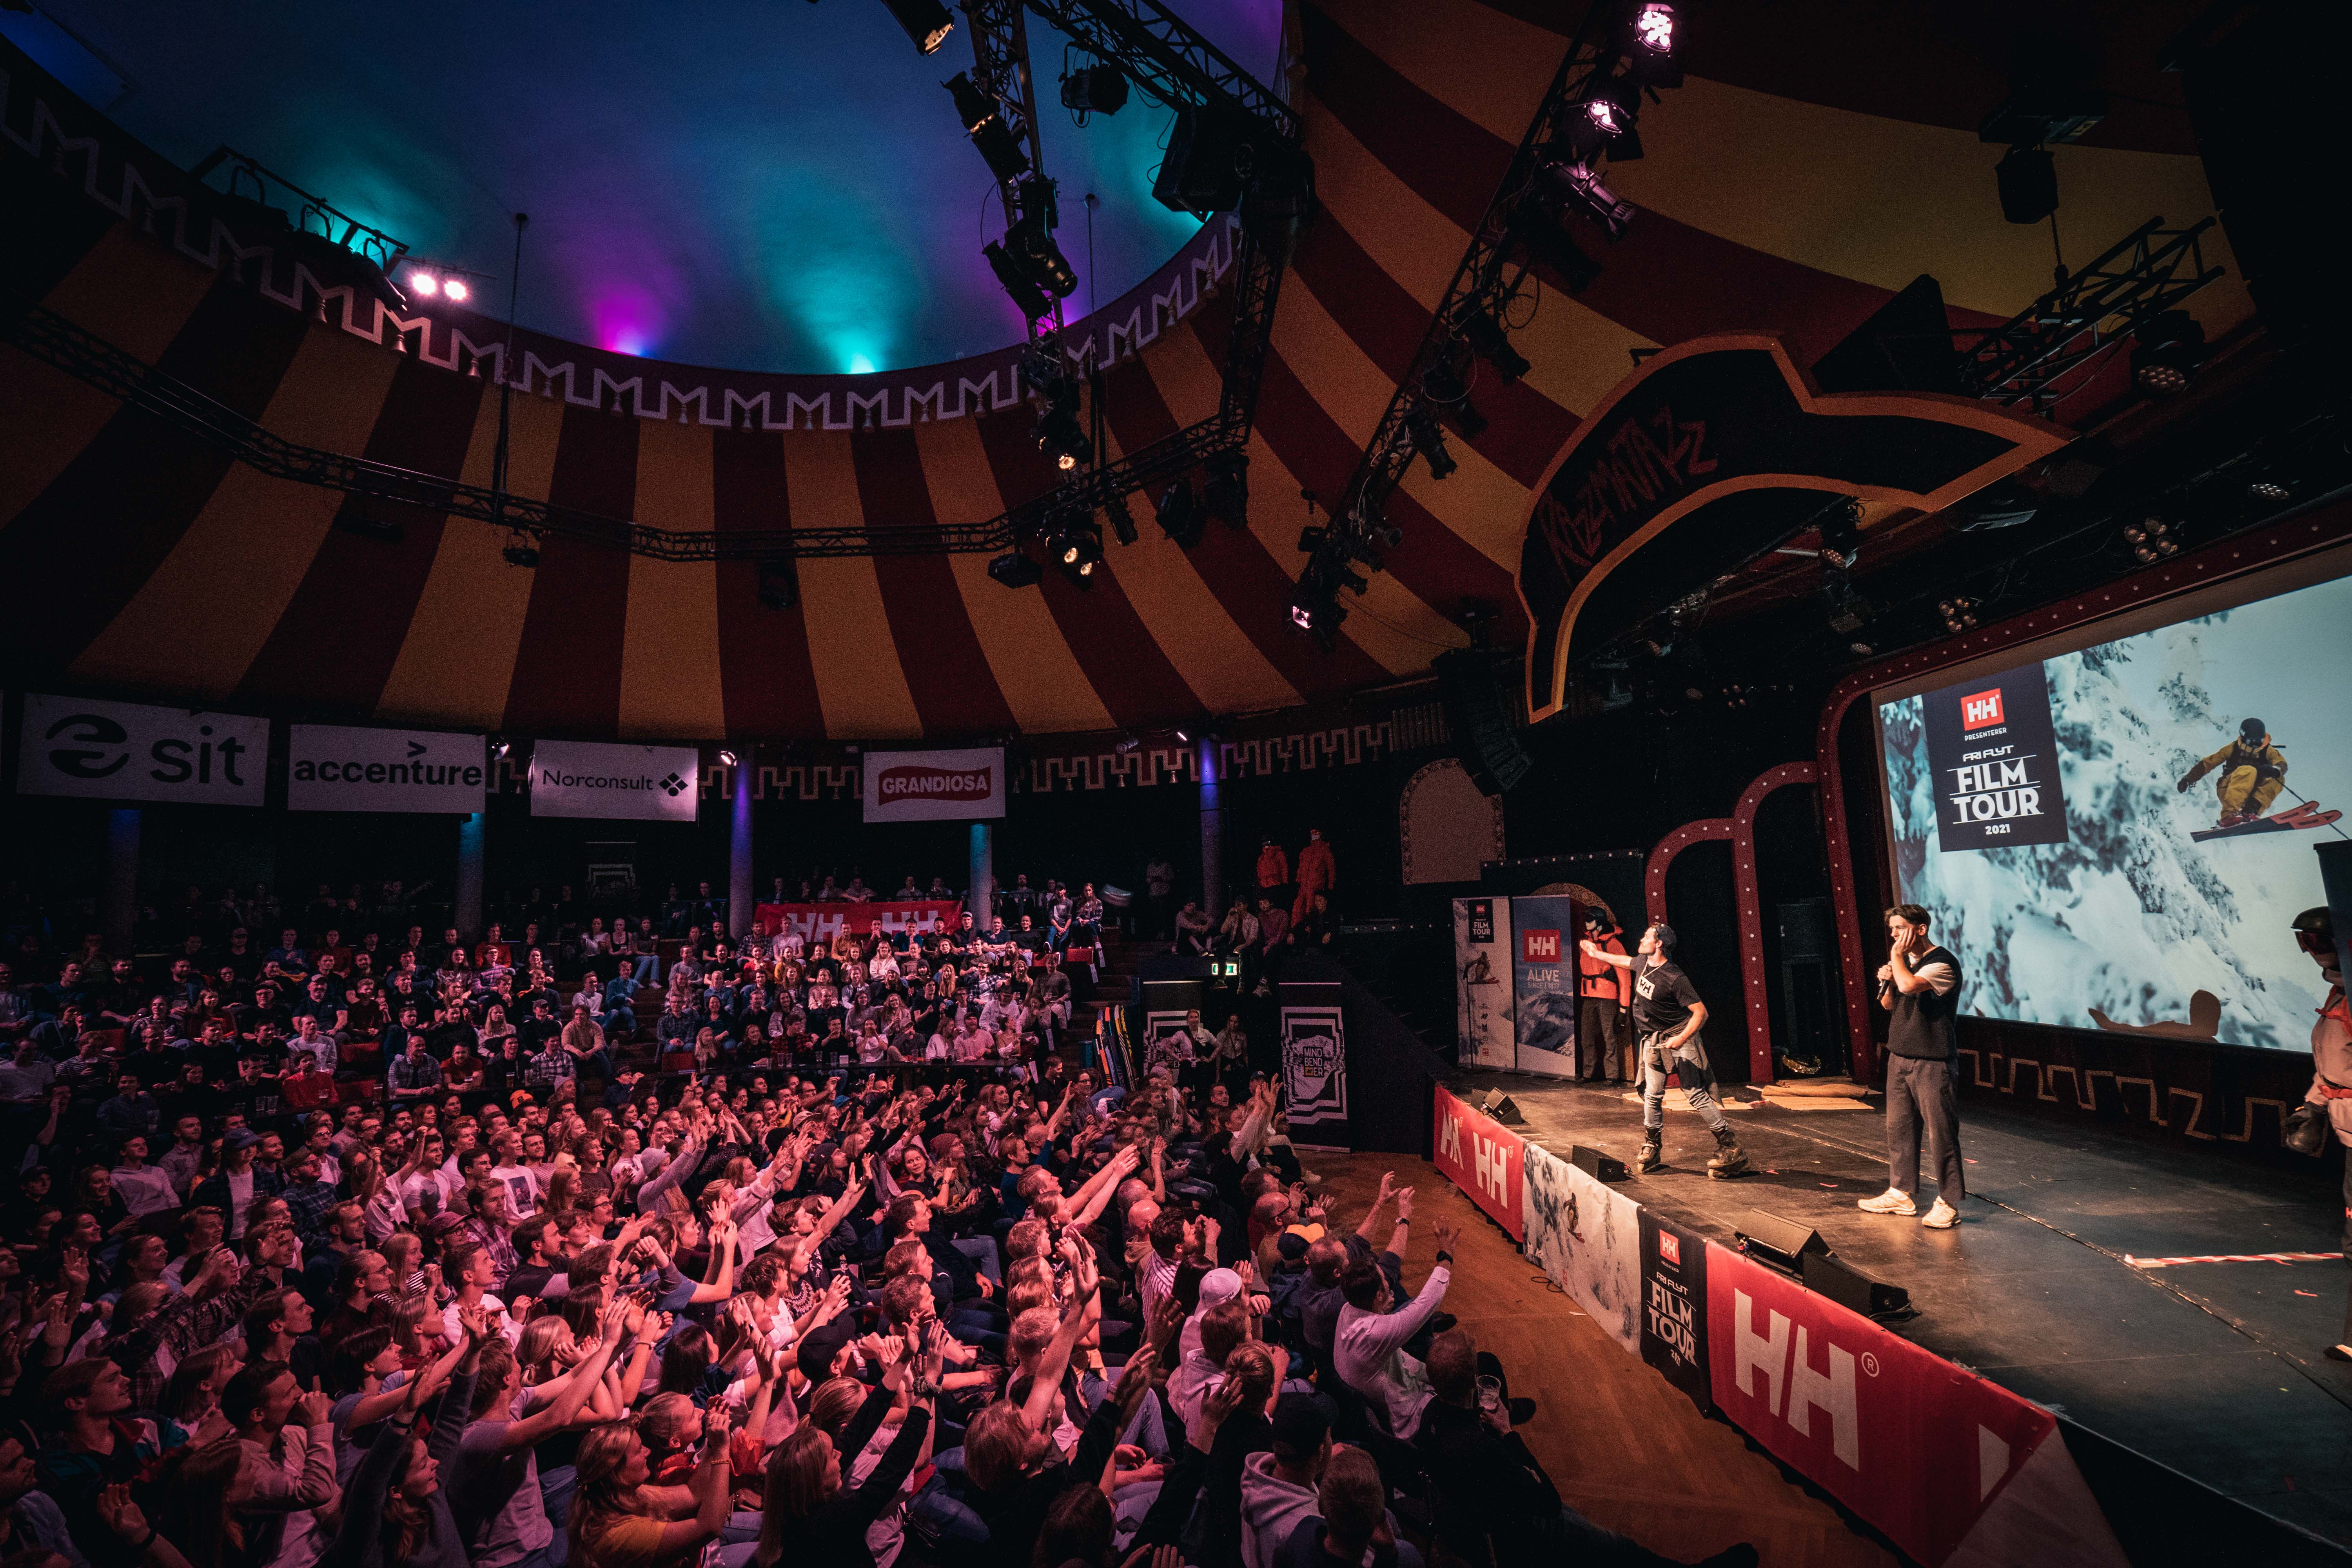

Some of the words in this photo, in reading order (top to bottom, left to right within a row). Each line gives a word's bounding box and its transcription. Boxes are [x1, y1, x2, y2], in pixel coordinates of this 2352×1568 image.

[1965, 727, 2007, 741] PRESENTERER
[150, 725, 245, 786] sit
[1963, 751, 1981, 762] FRI
[1983, 745, 2014, 758] FLYT
[294, 759, 482, 785] accenture
[543, 770, 653, 790] Norconsult
[1957, 758, 2027, 794] FILM
[882, 775, 987, 794] GRANDIOSA
[1954, 788, 2040, 822] TOUR
[1985, 824, 2011, 835] 2021
[1527, 969, 1559, 982] ALIVE
[1304, 1048, 1323, 1057] MIND
[1305, 1058, 1323, 1066] BEND
[1662, 1236, 1676, 1258] HH
[1657, 1271, 1667, 1285] FRI
[1668, 1279, 1688, 1295] FLYT
[1652, 1281, 1692, 1332] FILM
[1649, 1306, 1696, 1366] TOUR
[1670, 1349, 1681, 1367] 2021
